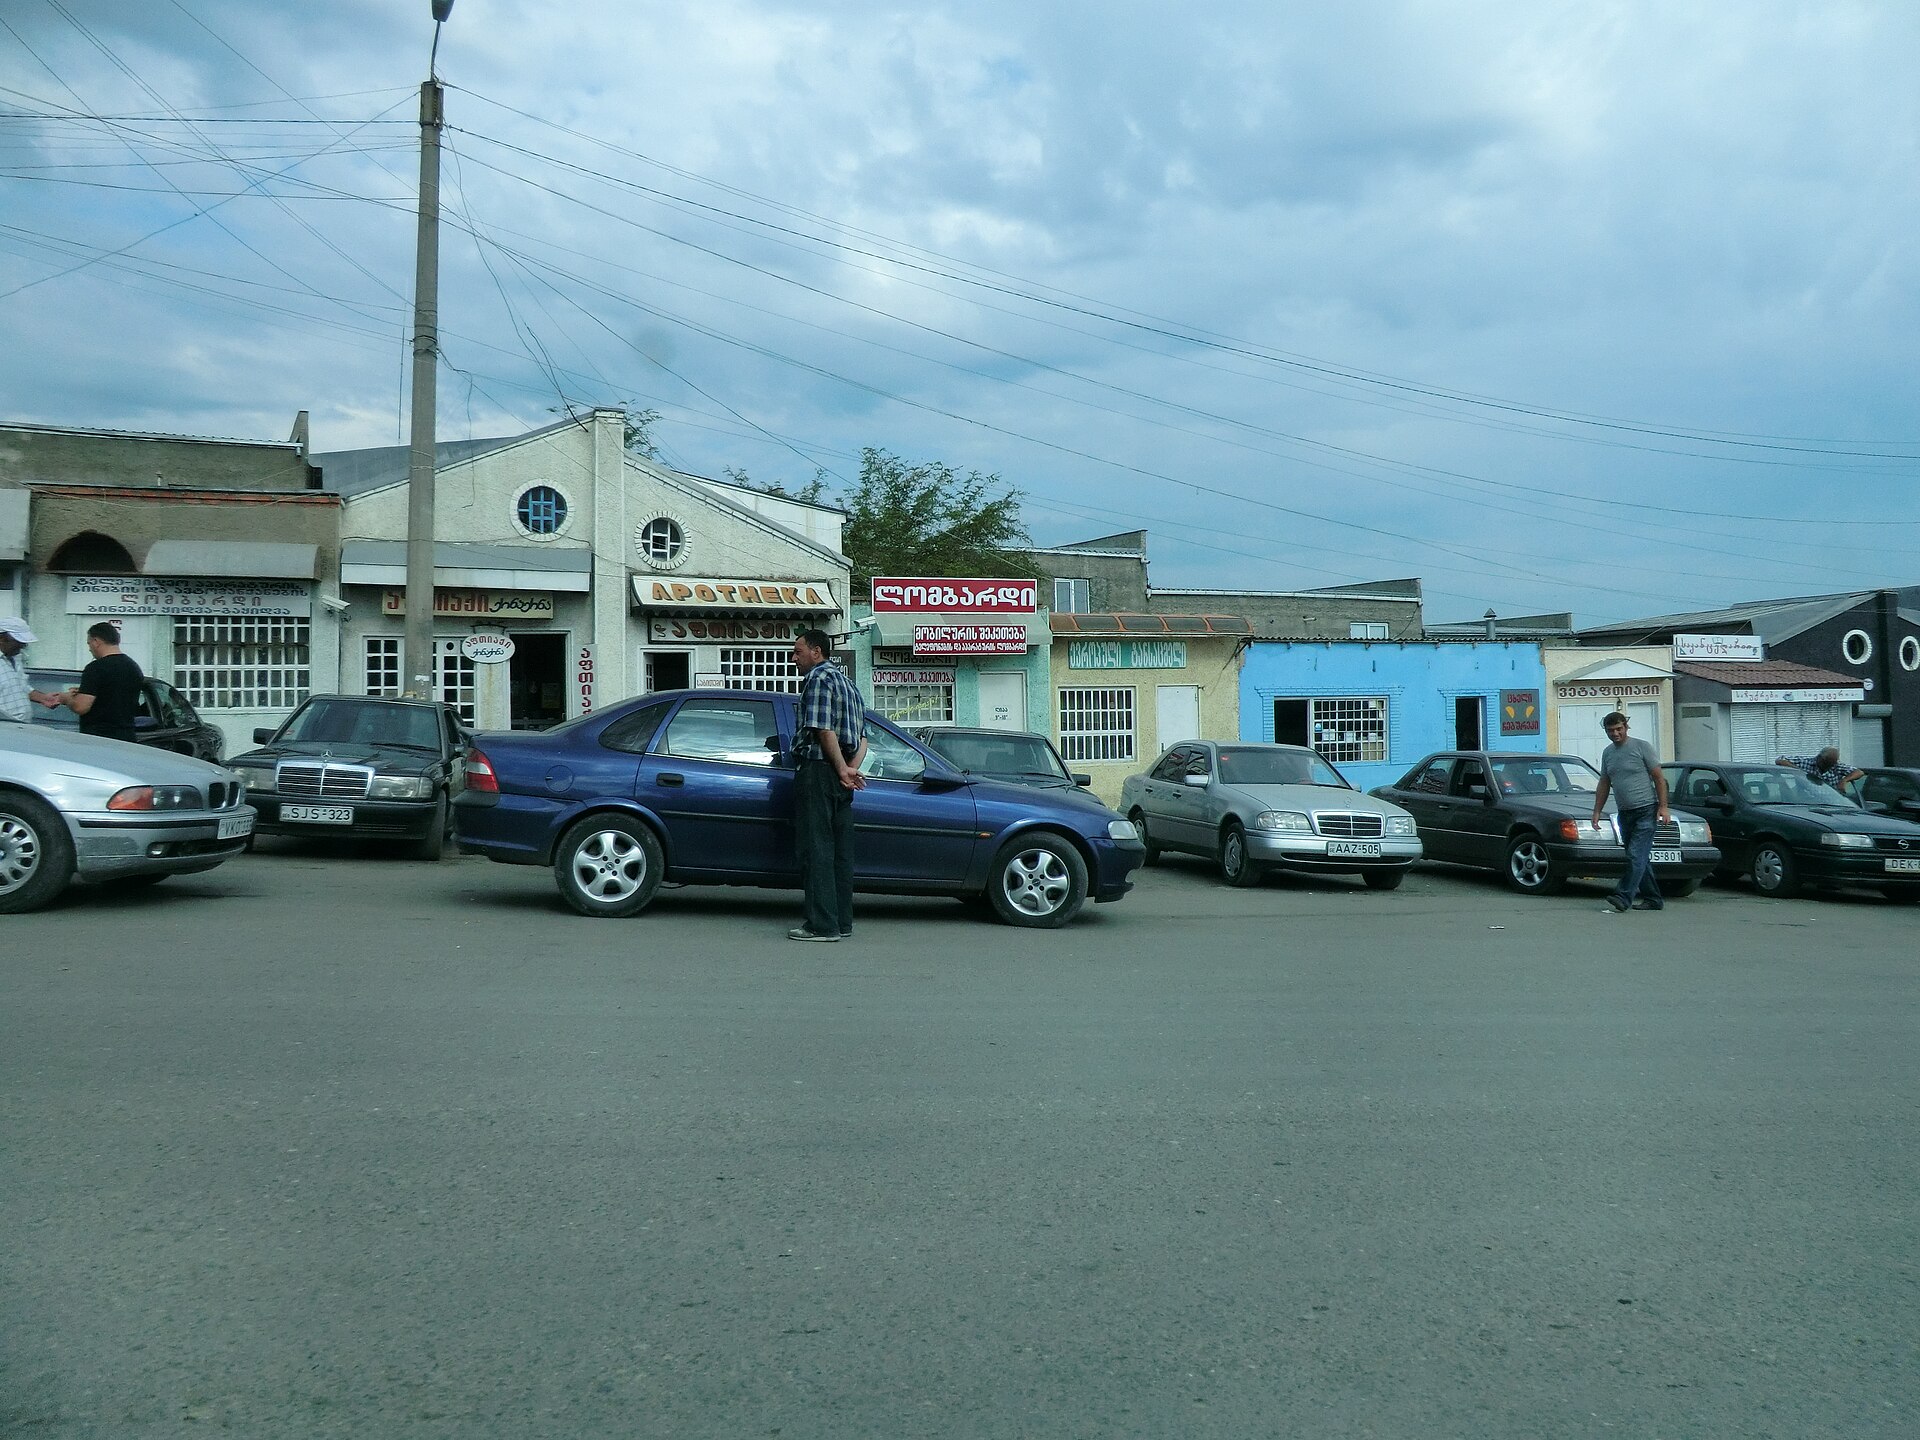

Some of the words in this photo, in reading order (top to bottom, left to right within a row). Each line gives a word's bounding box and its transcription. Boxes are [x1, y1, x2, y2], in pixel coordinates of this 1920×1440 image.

[71, 585, 140, 594] ბინების
[144, 586, 168, 595] და
[652, 582, 827, 605] APOTHEKA
[875, 585, 1036, 607] ლომბარდი
[120, 593, 262, 607] ლომბარდი
[386, 591, 489, 613] აიაქი
[87, 605, 156, 613] ბინების
[671, 621, 791, 639] აფთიაქი
[915, 627, 978, 641] მობილურის
[979, 628, 1026, 641] შეკეთება
[465, 634, 513, 649] აფთიაქი
[1069, 641, 1122, 668] ევროპული
[1131, 641, 1187, 668] ტანსაცმელი
[1558, 684, 1660, 698] ვეტაფთიაქი
[1335, 843, 1379, 855] AAZ-505
